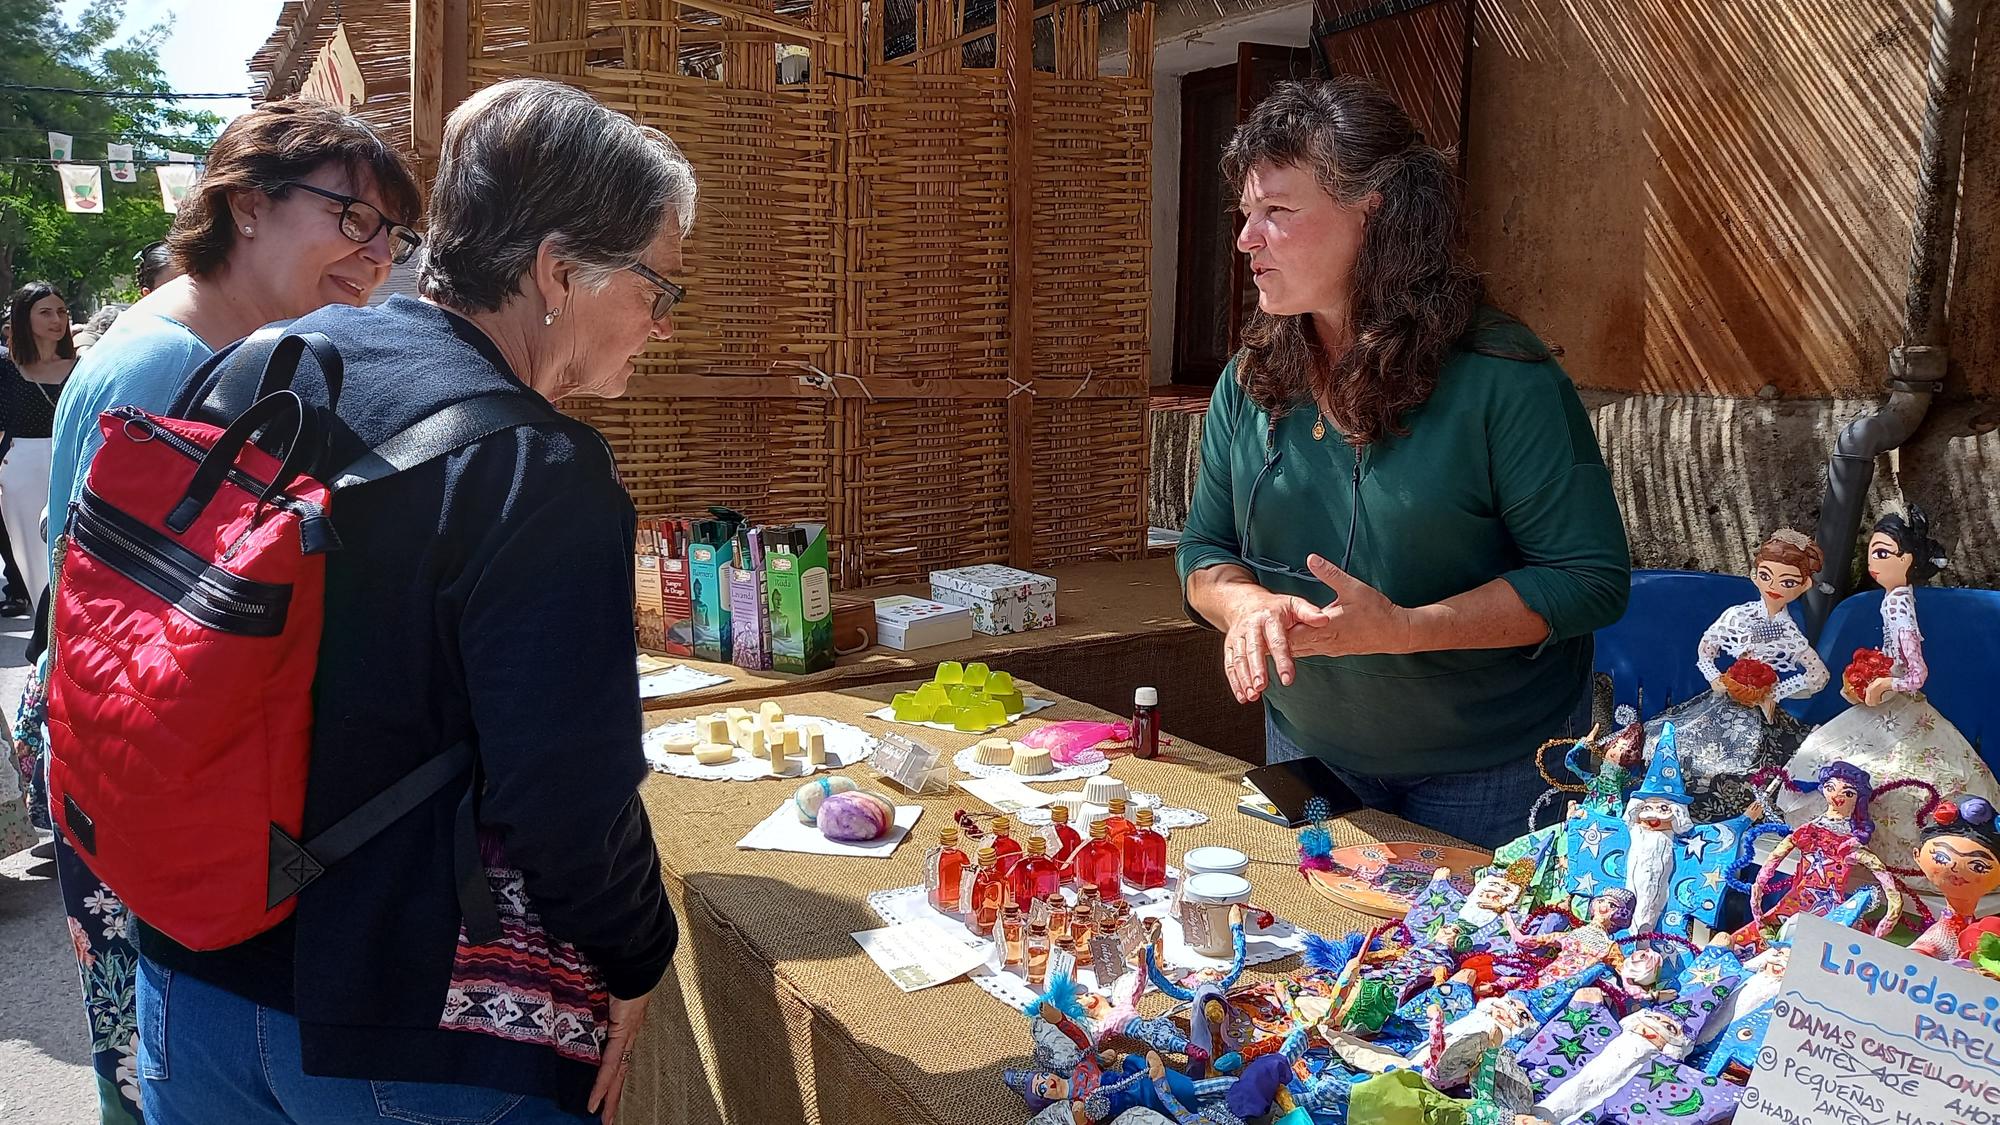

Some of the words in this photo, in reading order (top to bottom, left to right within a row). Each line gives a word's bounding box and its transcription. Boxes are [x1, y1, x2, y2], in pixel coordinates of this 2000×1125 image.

[665, 579, 682, 588] Sangre
[731, 590, 754, 601] Lavanda
[1100, 943, 1118, 978] integral
[1788, 1006, 1857, 1050] DAMAS
[1796, 1038, 1857, 1073] ANTES
